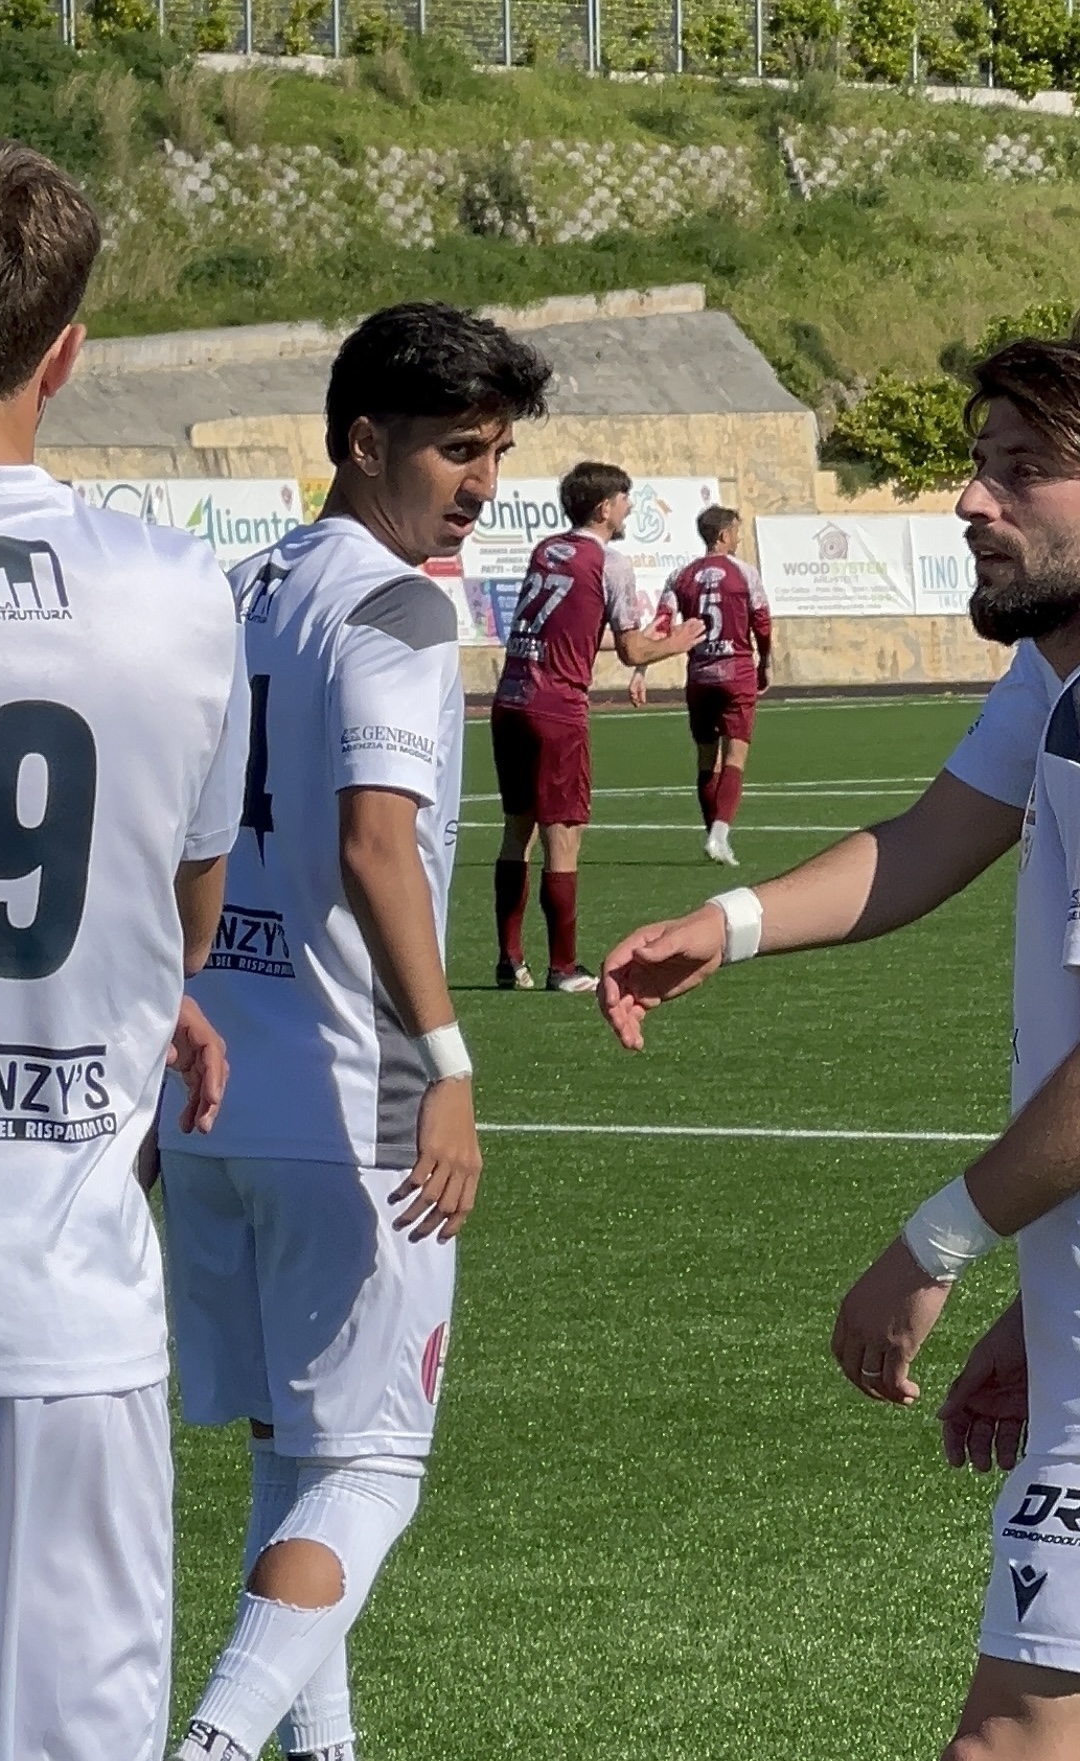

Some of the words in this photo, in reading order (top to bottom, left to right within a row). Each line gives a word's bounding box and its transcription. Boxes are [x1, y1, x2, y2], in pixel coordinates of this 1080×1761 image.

[919, 556, 959, 589] TINO
[512, 572, 575, 635] 27
[699, 593, 723, 641] 5
[362, 726, 435, 756] GENERALI
[25, 1117, 115, 1140] RISPARMIO
